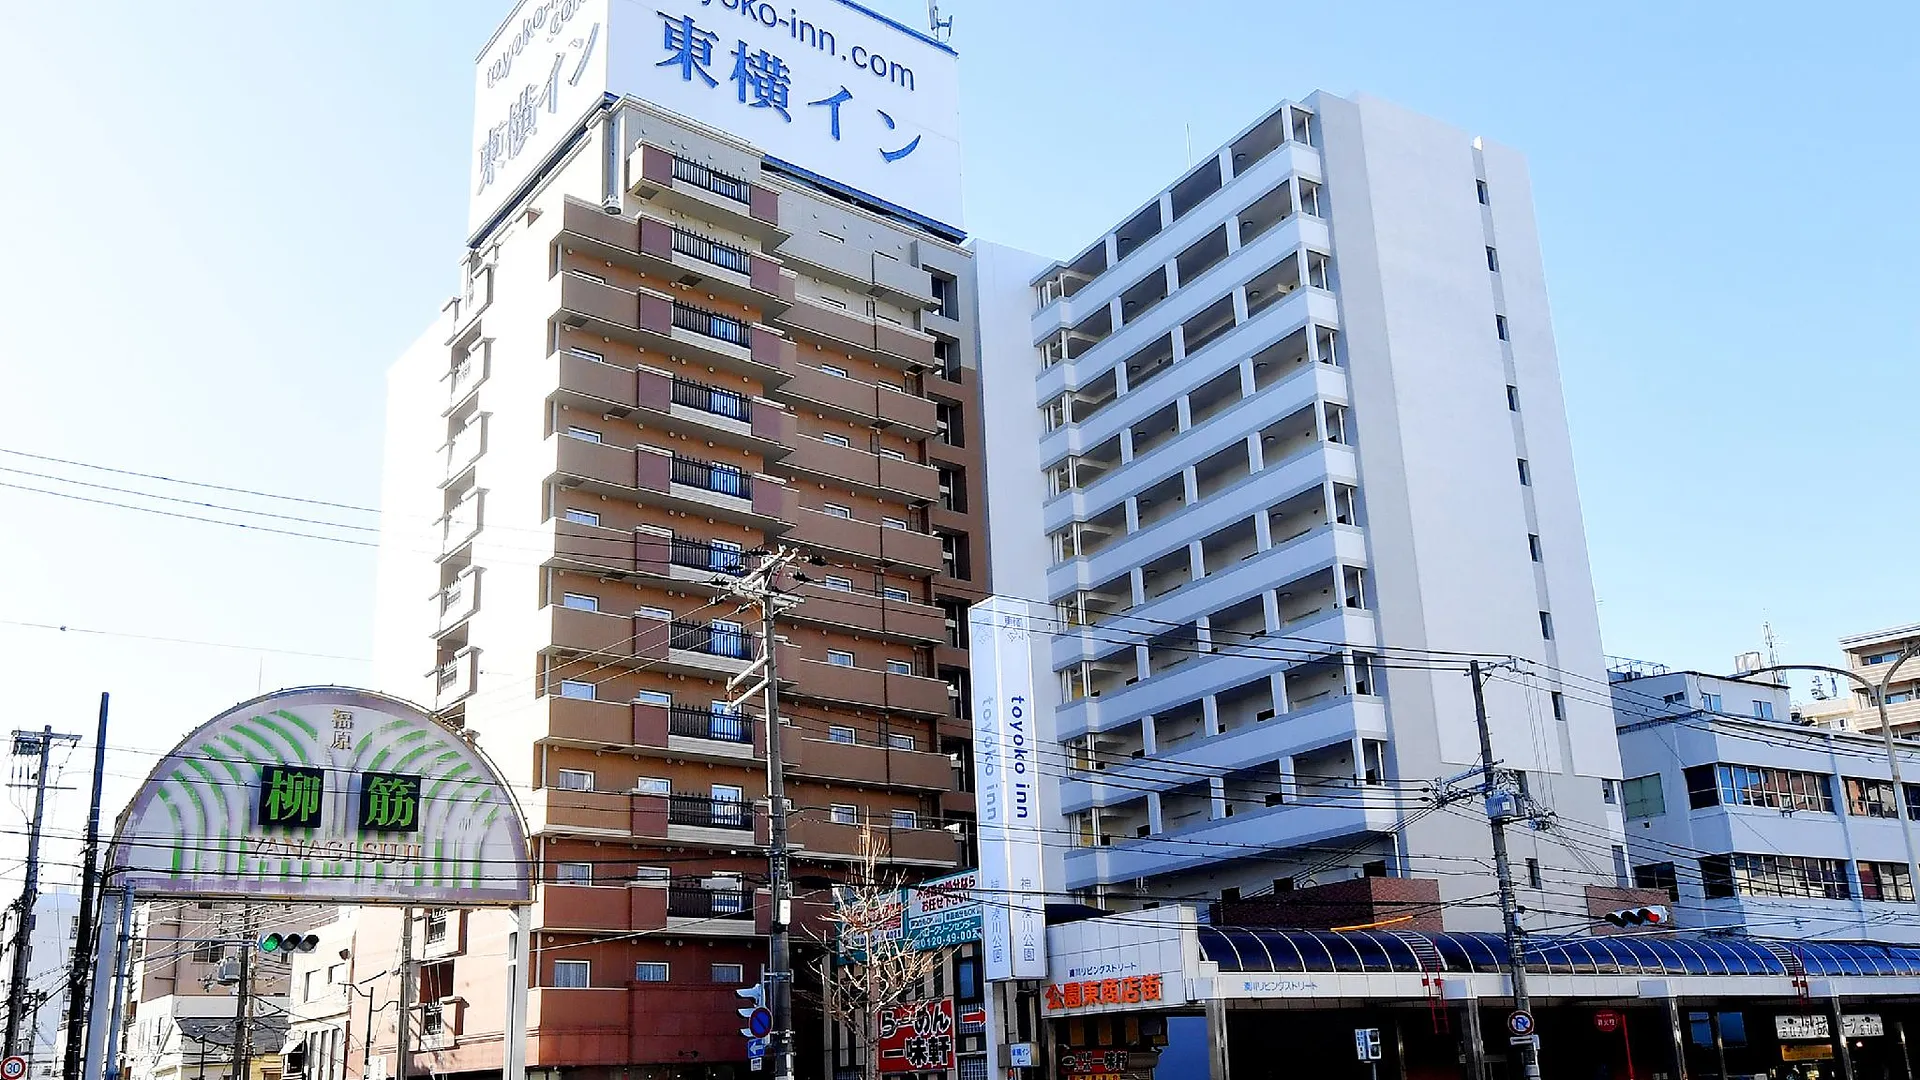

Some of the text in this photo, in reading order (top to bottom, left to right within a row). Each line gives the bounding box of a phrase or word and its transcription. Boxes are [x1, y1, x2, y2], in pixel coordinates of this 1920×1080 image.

[656, 10, 922, 164] 東横イン
[330, 708, 353, 751] 福原
[980, 696, 999, 820] toyoko inn
[1009, 695, 1031, 819] toyoko inn
[244, 836, 422, 865] YANAGI SUJI
[1045, 973, 1163, 1010] 公園東商店街
[6, 1062, 21, 1074] 30
[882, 1034, 952, 1069] 一味軒
